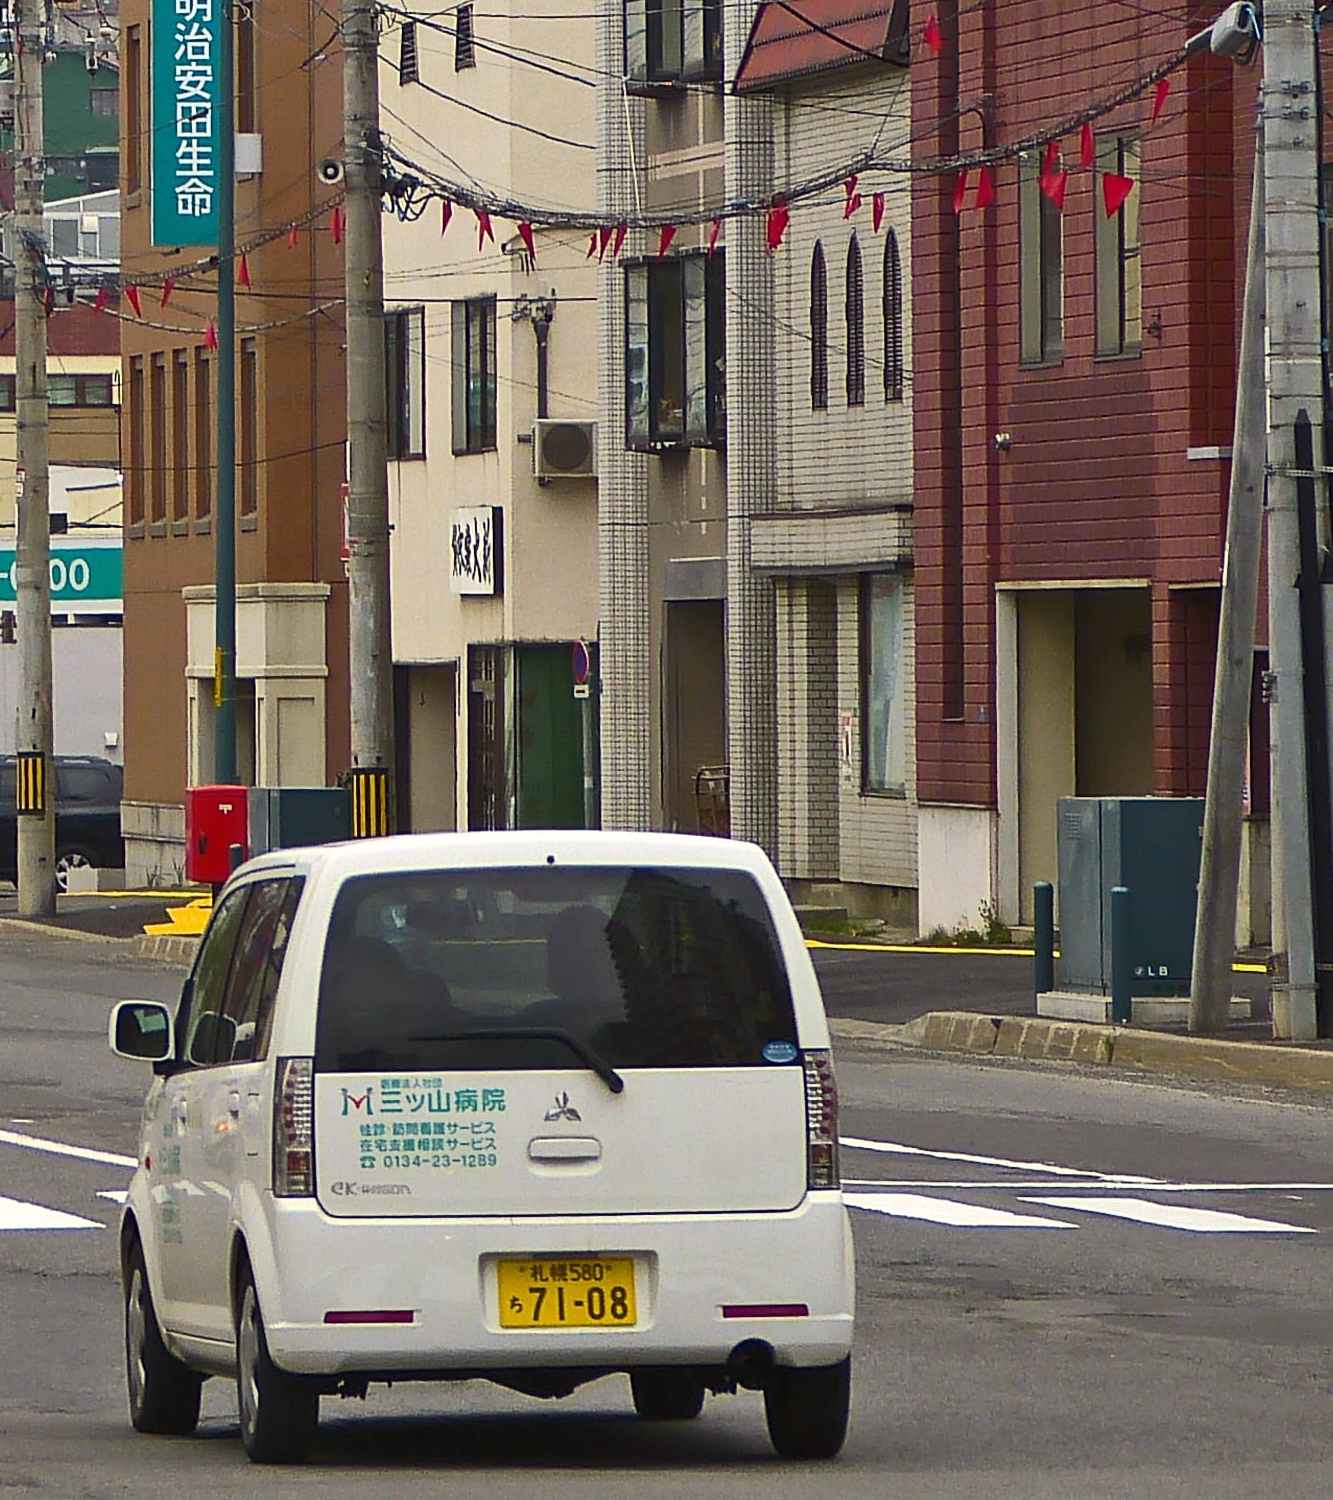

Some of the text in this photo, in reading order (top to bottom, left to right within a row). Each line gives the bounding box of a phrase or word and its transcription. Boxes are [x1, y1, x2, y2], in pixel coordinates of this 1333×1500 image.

[380, 1088, 506, 1114] 三ツ山病院
[529, 1285, 629, 1322] 71-08
